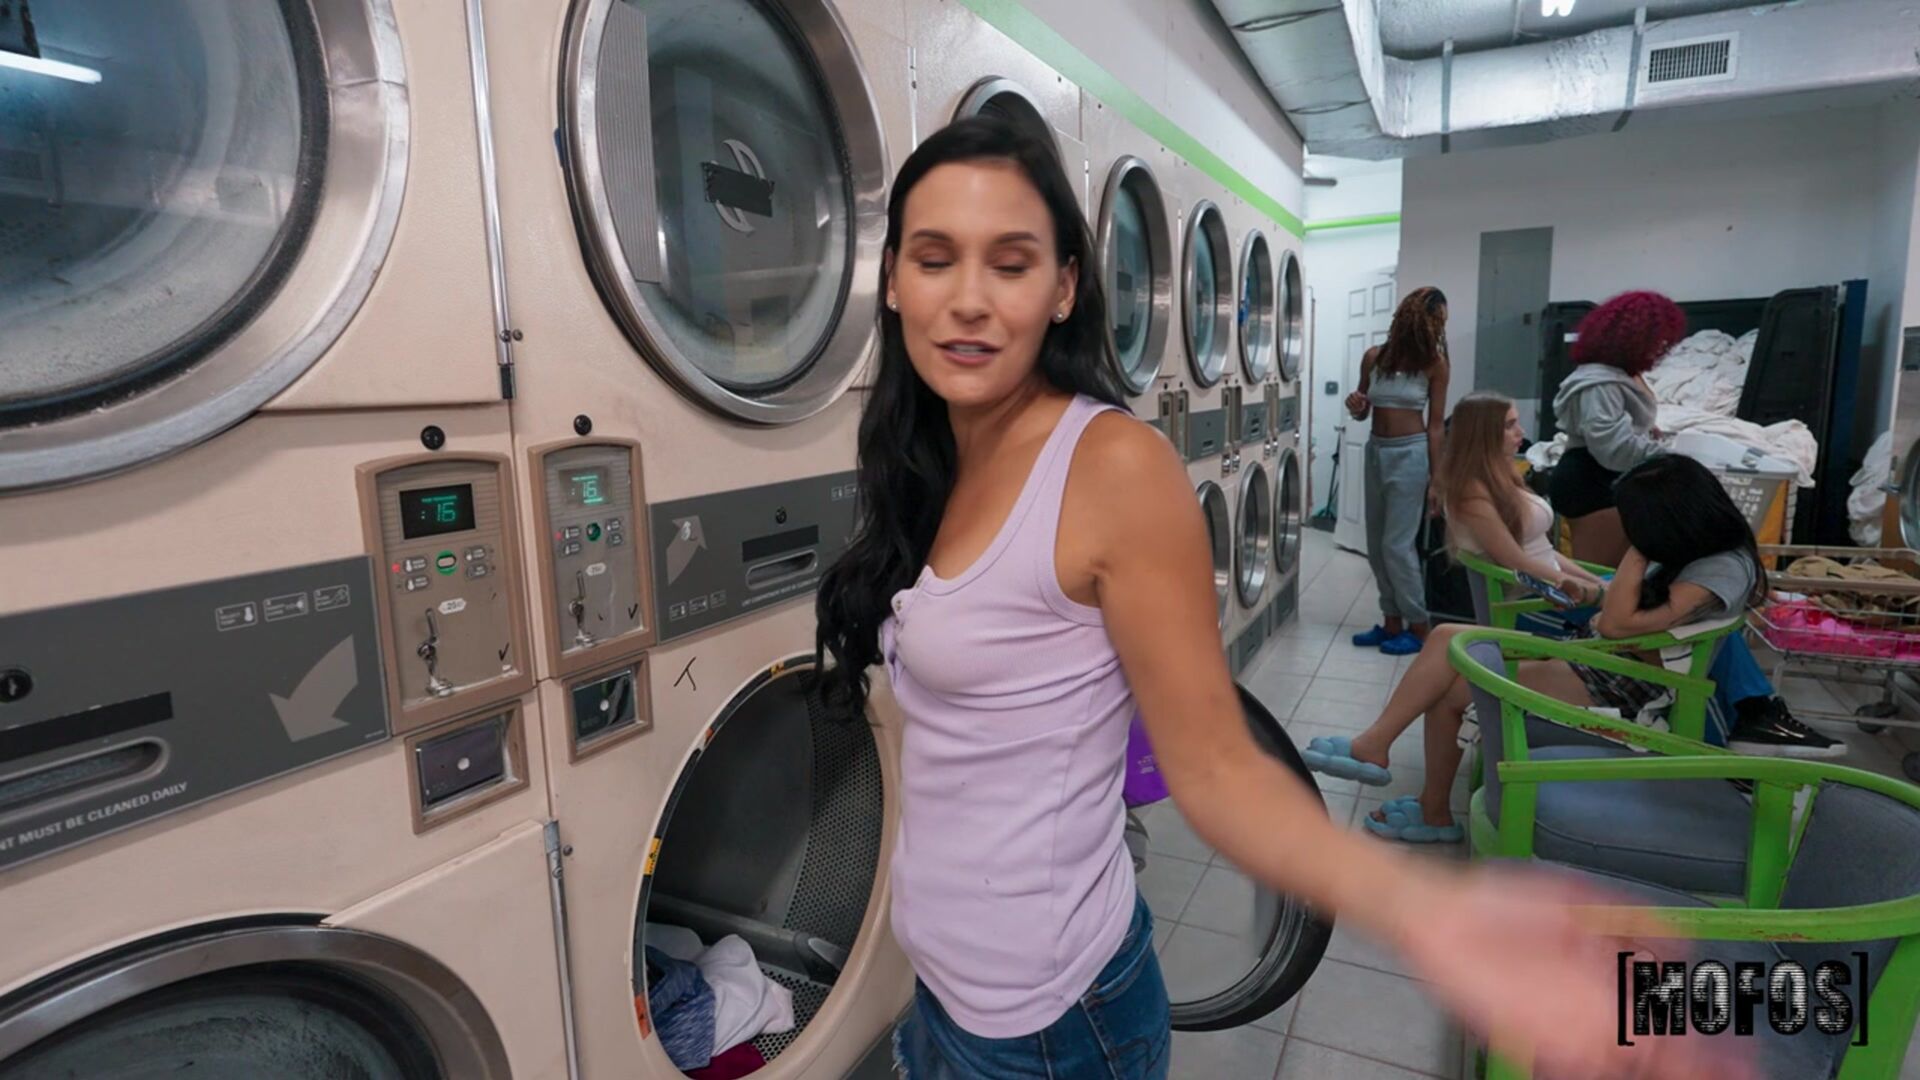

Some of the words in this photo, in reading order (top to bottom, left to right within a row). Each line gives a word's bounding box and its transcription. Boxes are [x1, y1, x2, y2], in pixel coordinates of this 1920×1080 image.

[18, 821, 63, 845] MUST
[65, 814, 86, 830] BE
[87, 794, 149, 823] CLEANED
[151, 781, 188, 802] DAILY
